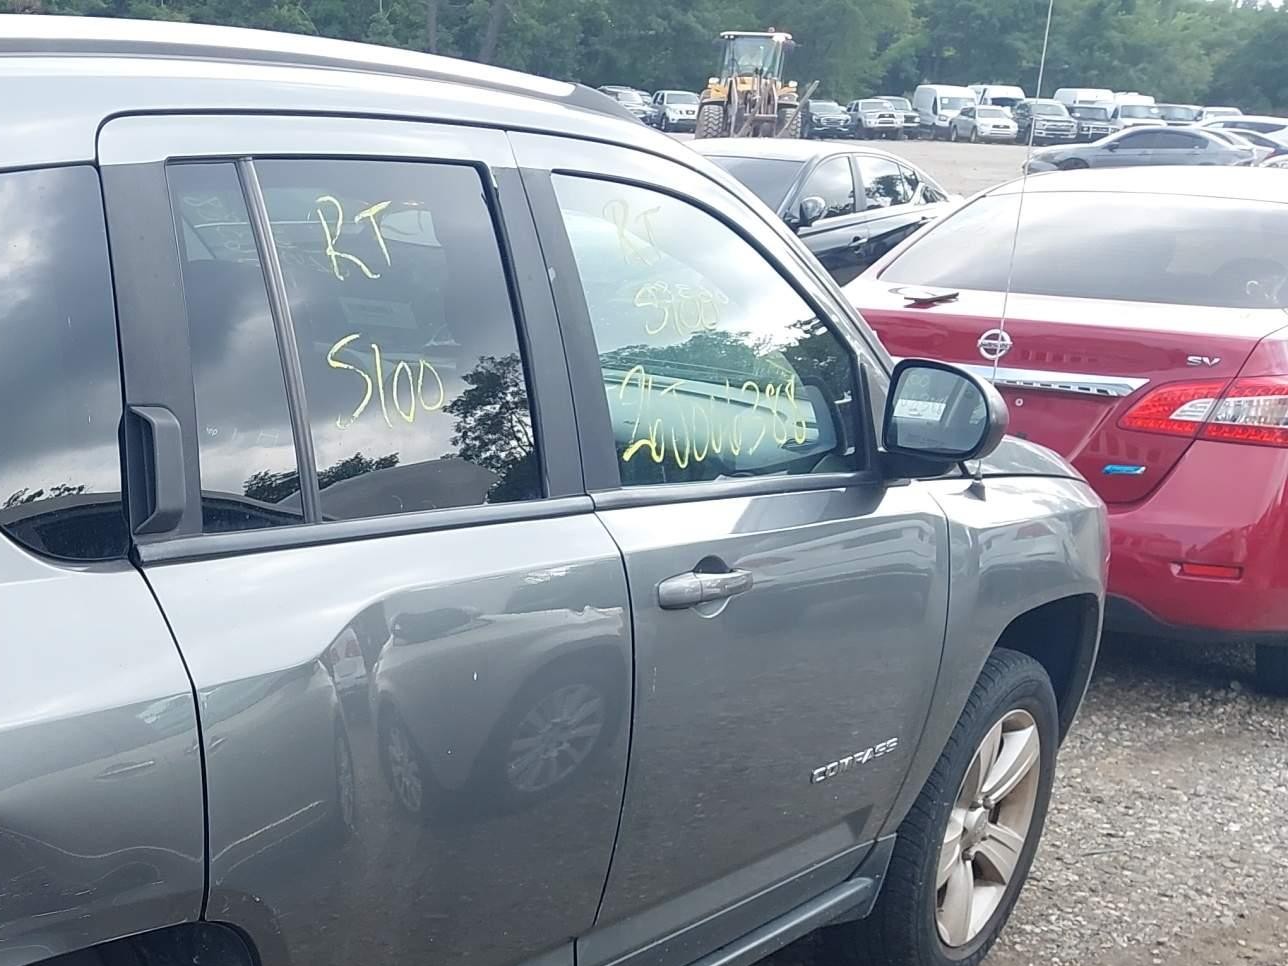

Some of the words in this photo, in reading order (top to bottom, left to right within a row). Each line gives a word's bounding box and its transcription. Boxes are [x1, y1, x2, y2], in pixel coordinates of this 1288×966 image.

[309, 195, 393, 281] RT
[1186, 355, 1222, 367] SV
[810, 737, 898, 783] COMPASS
